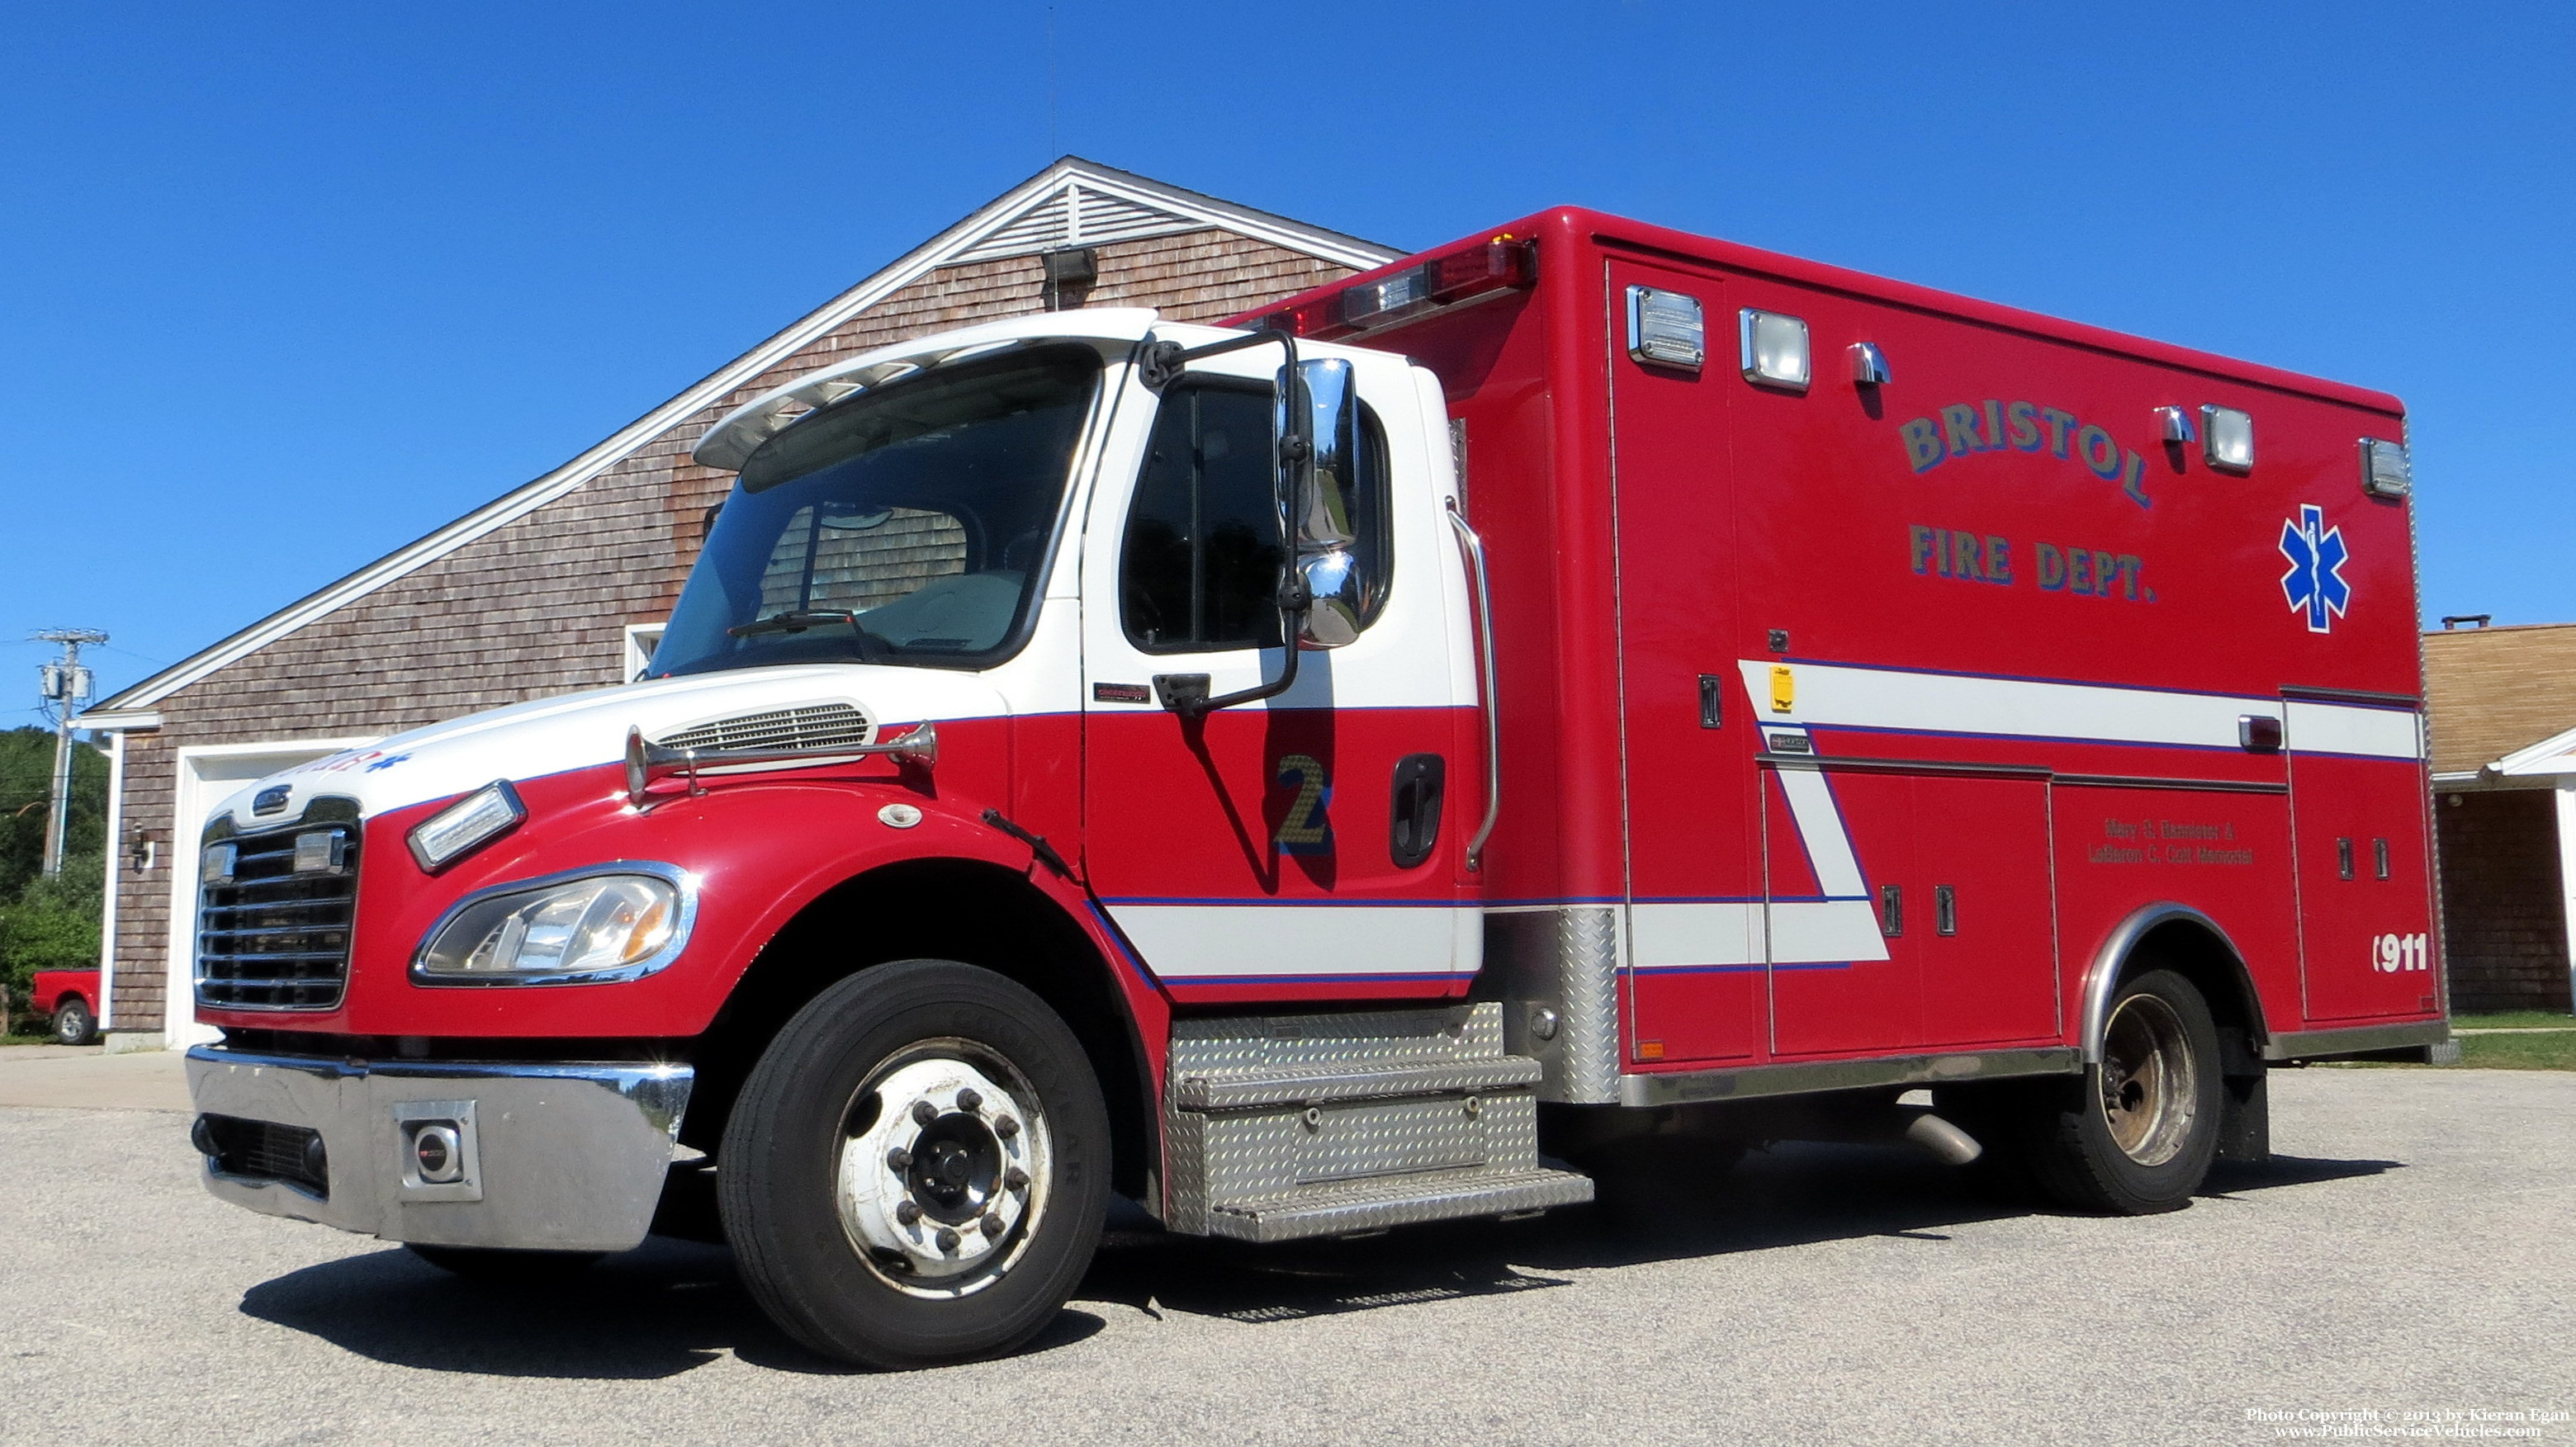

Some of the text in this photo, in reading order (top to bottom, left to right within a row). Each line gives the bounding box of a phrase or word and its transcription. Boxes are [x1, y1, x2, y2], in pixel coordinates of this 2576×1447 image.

[1899, 400, 2152, 510] BRISTOL
[1909, 523, 2157, 603] FIRE DEPT.
[1273, 754, 1336, 856] 2
[2199, 846, 2254, 866] Memorial
[2381, 933, 2427, 973] 911
